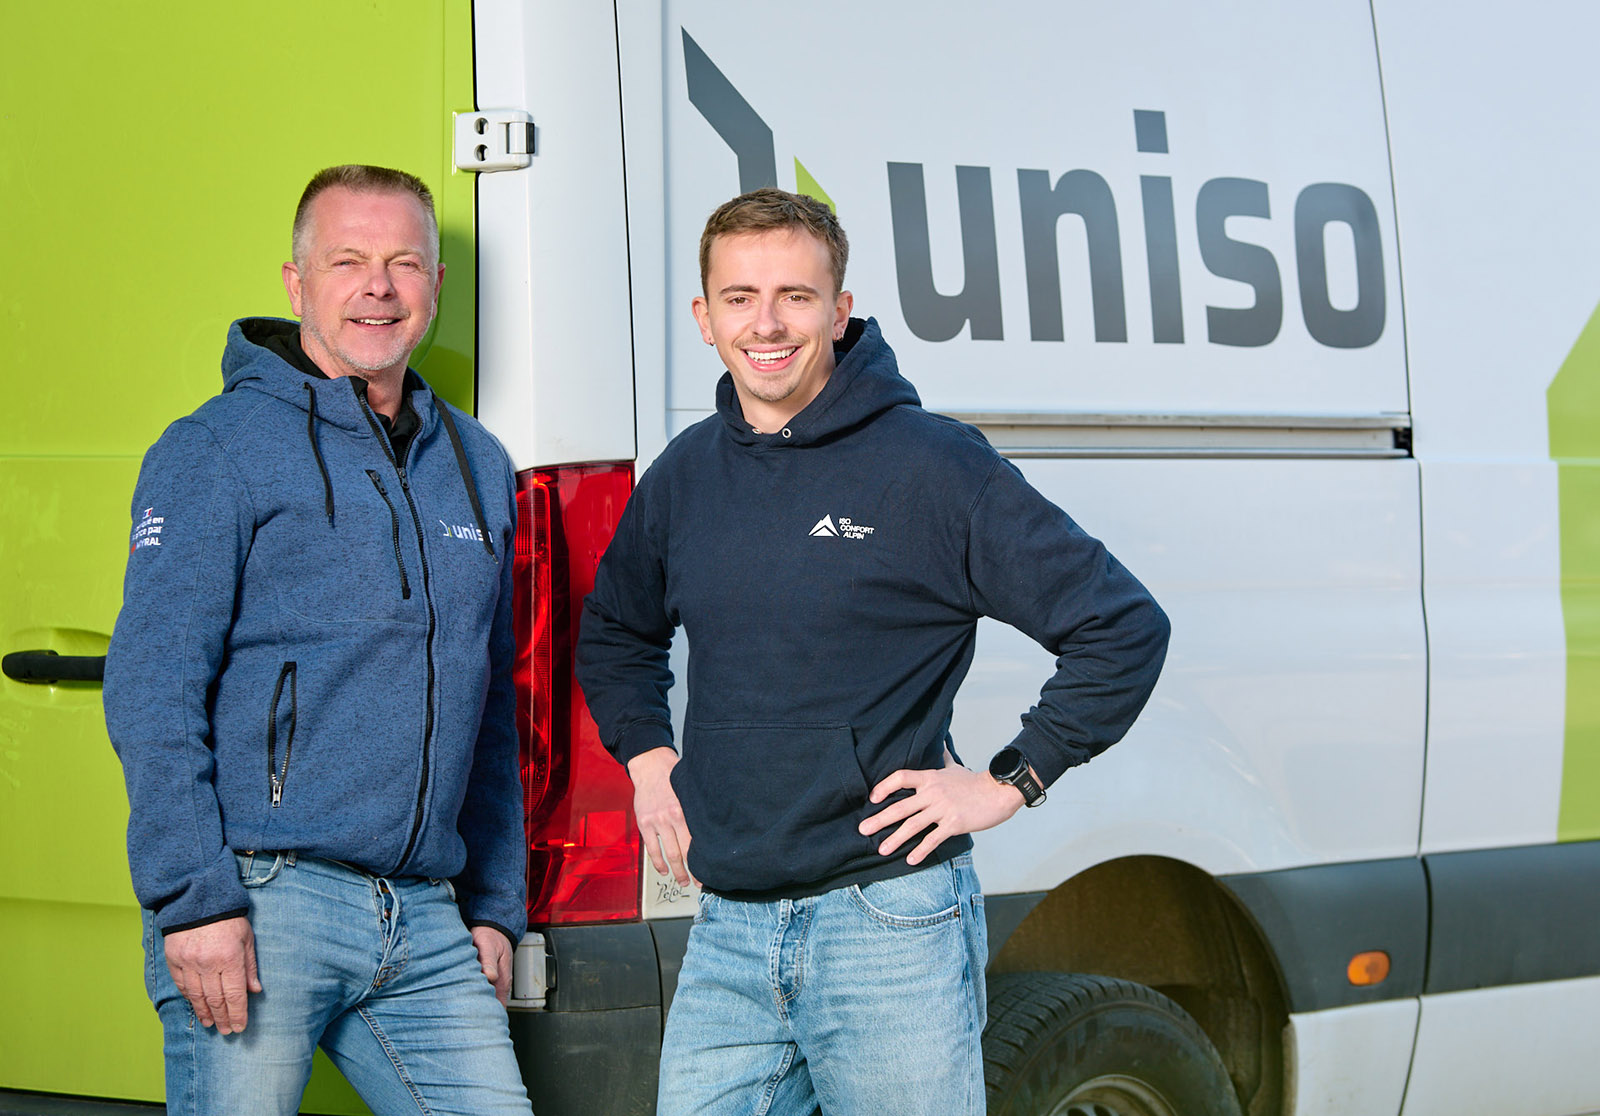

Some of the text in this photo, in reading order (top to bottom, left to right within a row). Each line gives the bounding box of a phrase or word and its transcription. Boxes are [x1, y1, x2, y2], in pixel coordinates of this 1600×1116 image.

[887, 109, 1387, 349] uniso
[839, 517, 852, 525] ISO
[148, 526, 162, 535] par
[452, 523, 493, 543] unis
[840, 524, 875, 534] CONFORT
[843, 531, 865, 540] ALPIN
